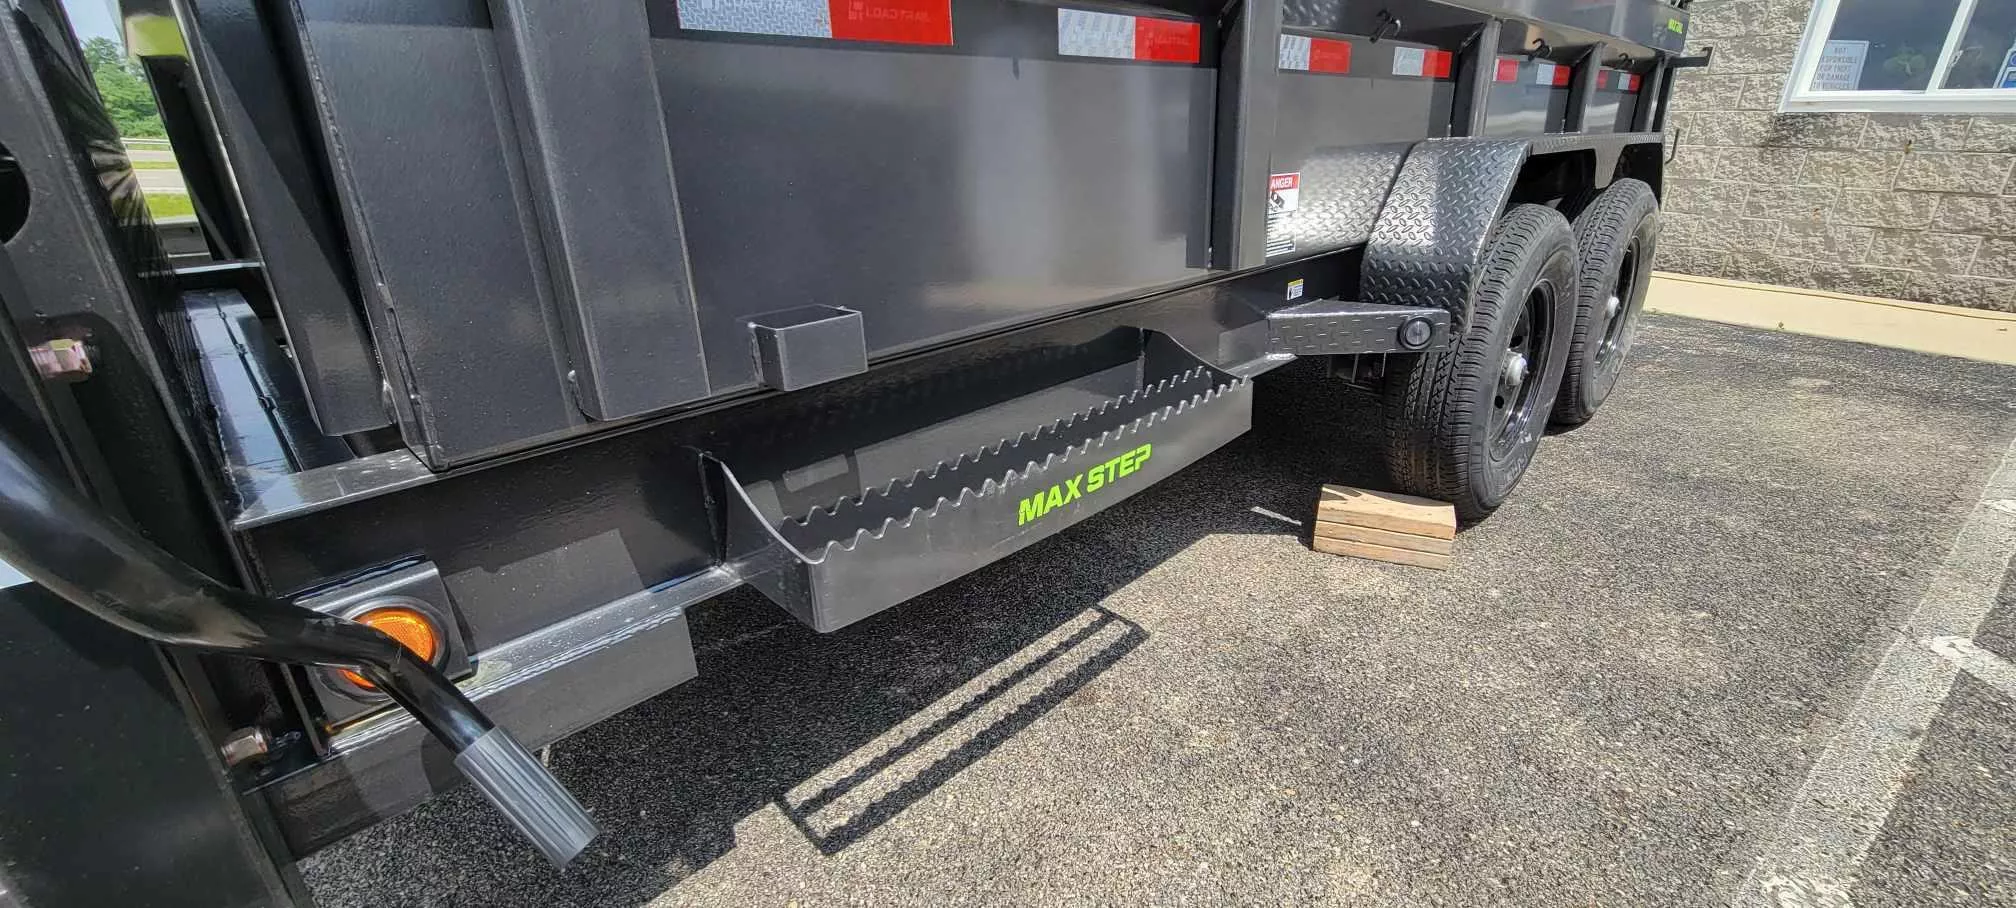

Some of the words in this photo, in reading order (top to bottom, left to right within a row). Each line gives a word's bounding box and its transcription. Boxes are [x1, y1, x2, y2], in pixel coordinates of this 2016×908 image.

[1820, 56, 1857, 64] ESPONSIBLE
[1269, 177, 1294, 191] ANGER
[1018, 473, 1083, 526] MAX
[1086, 443, 1152, 493] STEP
